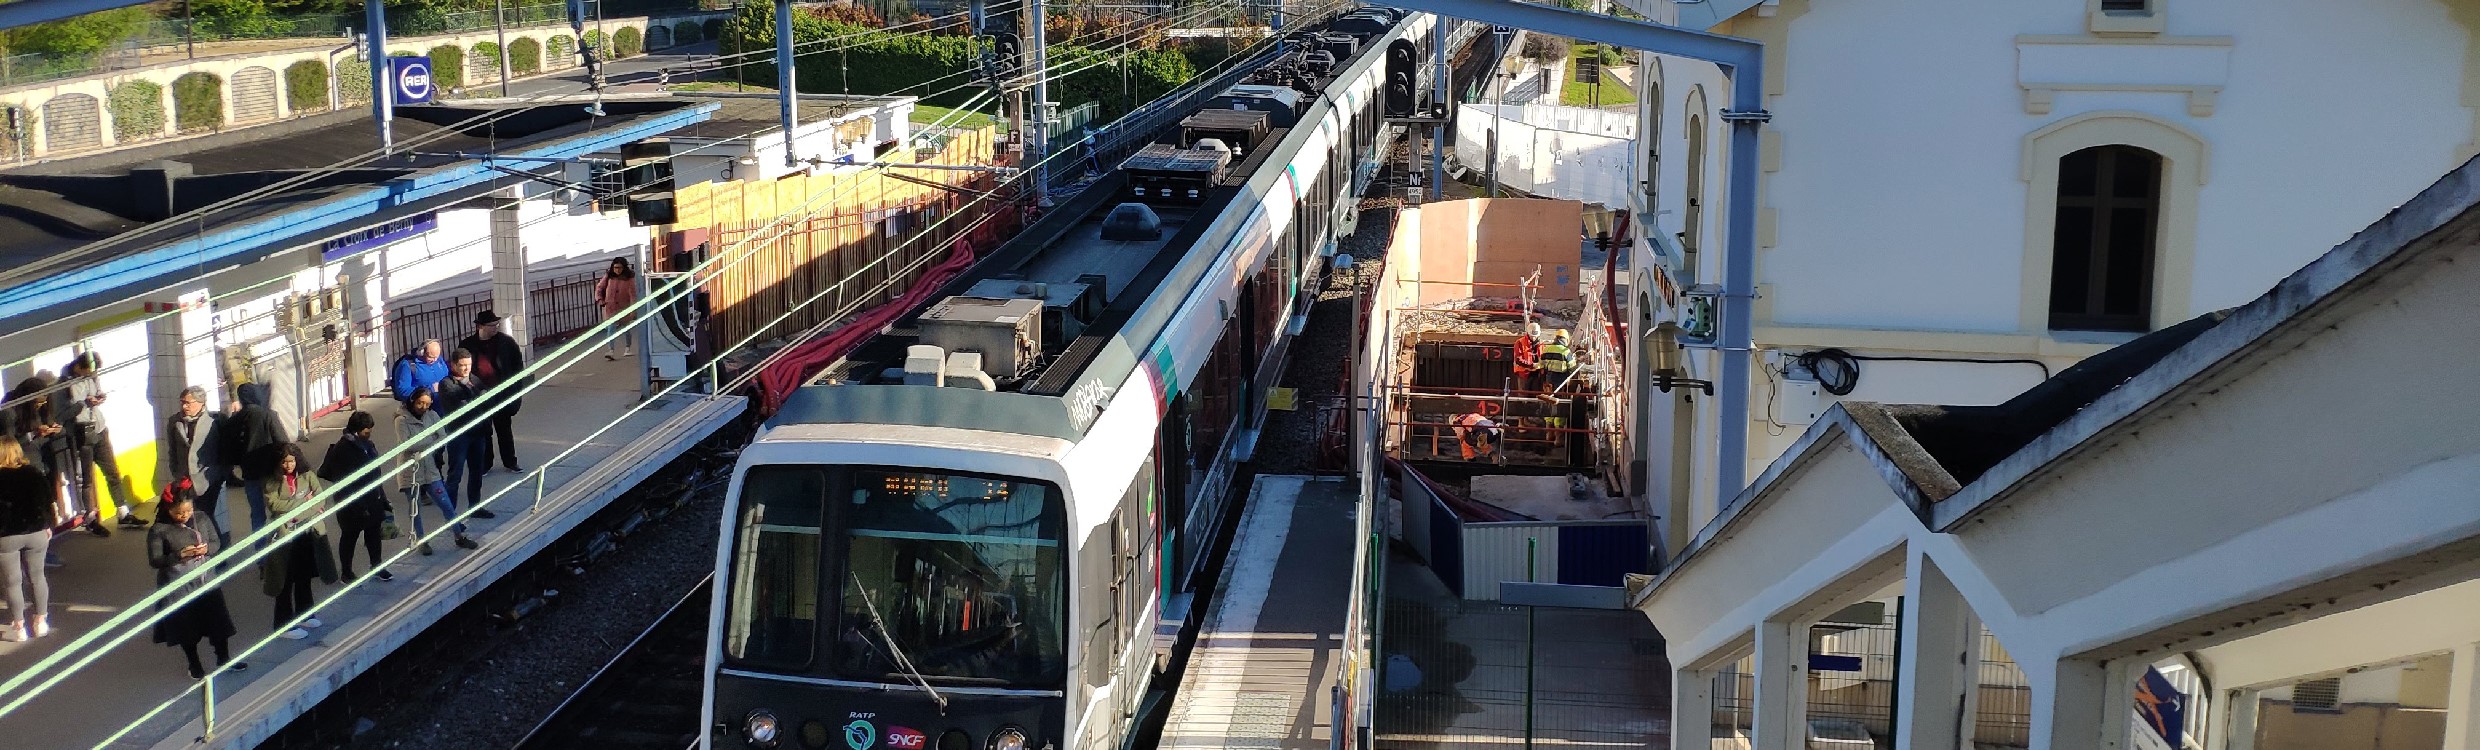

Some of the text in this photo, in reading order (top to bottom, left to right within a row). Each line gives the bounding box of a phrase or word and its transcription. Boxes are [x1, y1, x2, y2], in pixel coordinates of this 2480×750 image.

[327, 216, 414, 252] La Croix de Berny
[849, 711, 876, 719] RATP
[888, 733, 925, 746] SNCF
